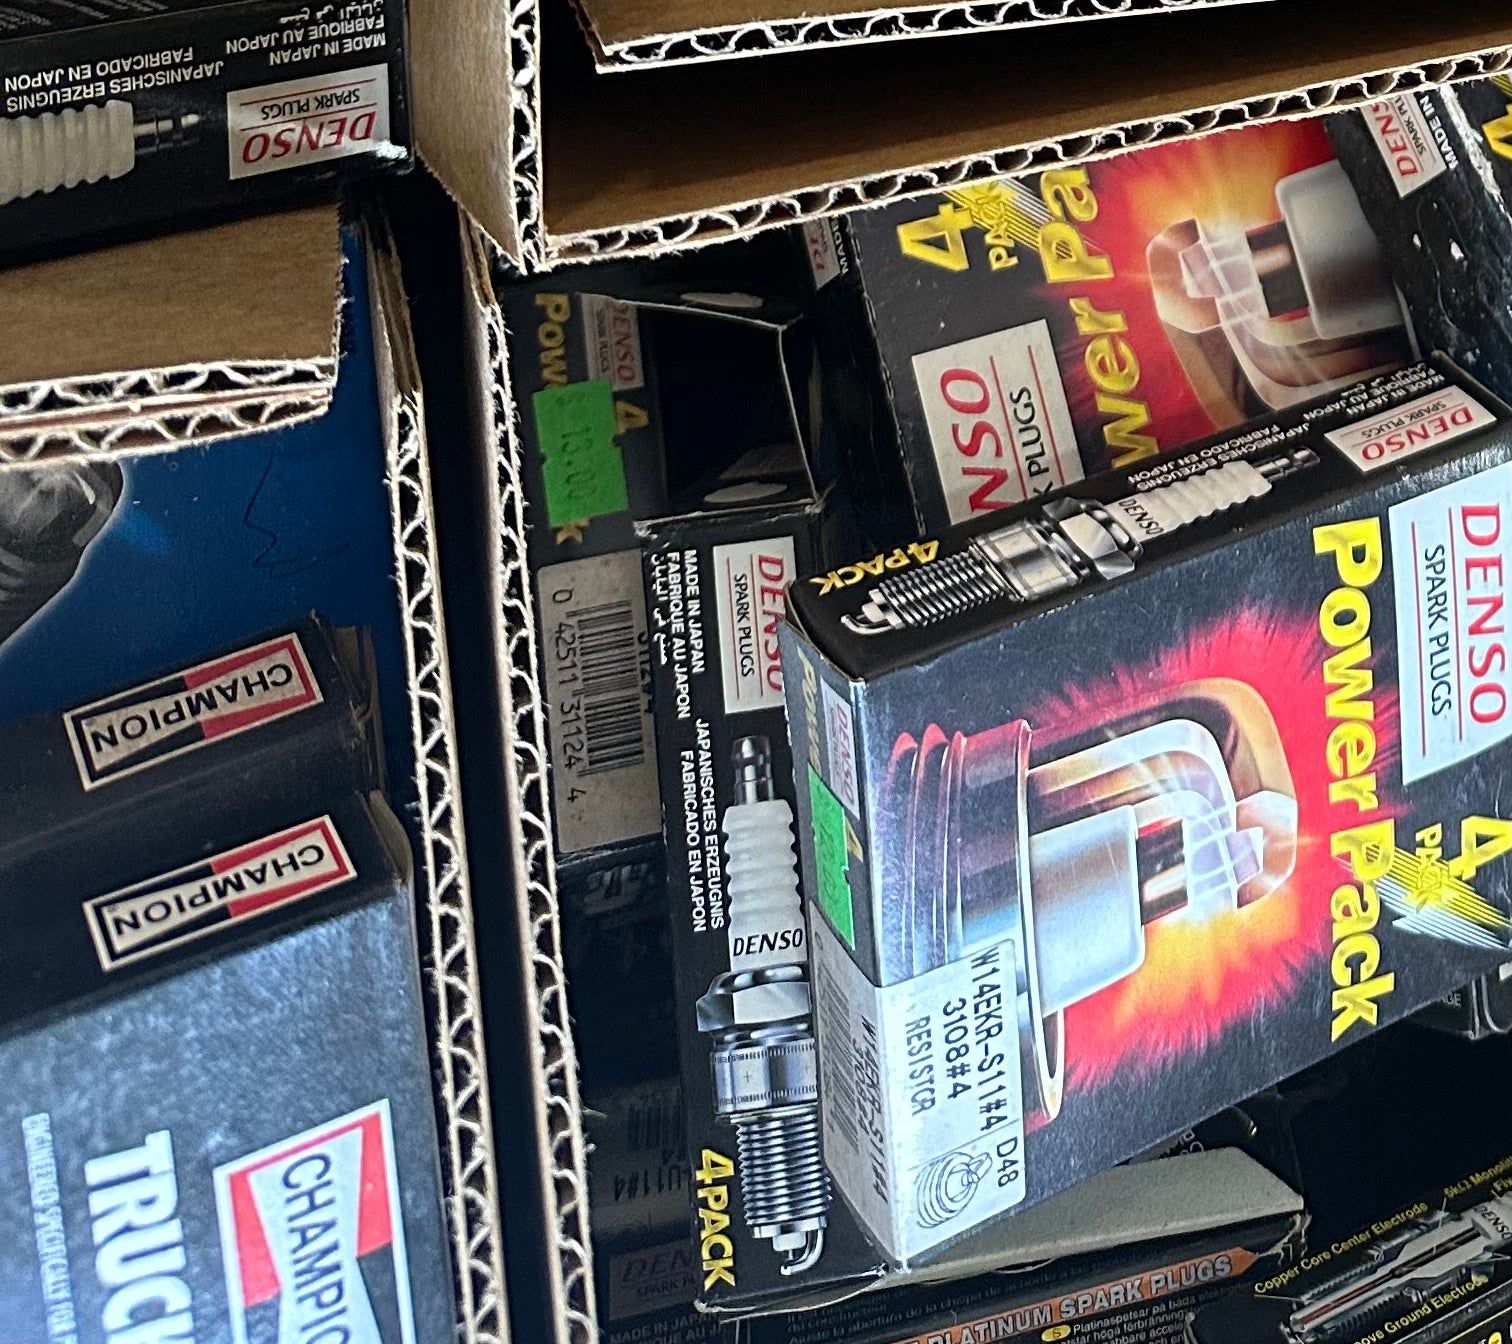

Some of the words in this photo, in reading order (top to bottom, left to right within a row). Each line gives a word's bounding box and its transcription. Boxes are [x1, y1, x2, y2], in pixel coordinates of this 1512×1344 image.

[226, 32, 280, 55] JAPON
[283, 25, 305, 43] AU
[315, 14, 385, 40] FABRIQUE
[324, 40, 341, 55] IN
[343, 32, 386, 51] MADE
[4, 68, 65, 93] JAPON
[69, 63, 92, 81] EN
[97, 46, 194, 76] FABRICADO
[109, 60, 224, 95] JAPANISCHES
[269, 43, 322, 66] JAPAN
[6, 81, 106, 112] ERZEUGNIS
[261, 97, 311, 121] PLUGS
[315, 87, 361, 111] SPARK
[242, 111, 377, 164] DENSO
[1360, 406, 1474, 461] DENSO
[552, 588, 574, 604] 0
[666, 552, 684, 628] FABRIQUE
[684, 549, 699, 593] MADE
[1421, 543, 1450, 632] SPARK
[686, 597, 700, 615] IN
[732, 572, 752, 624] SPARK
[1458, 501, 1509, 726] DENSO
[554, 623, 582, 698] 42511
[671, 632, 686, 652] AU
[688, 618, 706, 674] JAPAN
[737, 626, 756, 677] PLUGS
[1311, 515, 1386, 813] Power
[674, 657, 692, 720] JAPON
[1425, 636, 1454, 719] PLUGS
[89, 661, 296, 755] CHAMPION
[560, 699, 586, 770] 31124
[566, 787, 587, 803] 4
[680, 750, 703, 839] FABRICADO
[695, 718, 718, 836] JAPANISCHES
[687, 844, 704, 862] EN
[112, 842, 327, 936] CHAMPION
[692, 866, 708, 933] JAPON
[706, 840, 725, 929] ERZEUGNIS
[732, 928, 804, 958] DENSO
[1329, 814, 1398, 1045] Pack
[904, 1014, 937, 1116] RESISTOR
[941, 997, 973, 1102] 3108#4
[994, 1138, 1021, 1190] D48
[1253, 1261, 1304, 1300] Copper
[1299, 1245, 1335, 1274] Core
[1330, 1224, 1376, 1259] Center
[1371, 1197, 1430, 1239] Electrode
[926, 1304, 1053, 1344] PLATINUM
[1059, 1278, 1143, 1320] SPARK
[1149, 1255, 1233, 1295] PLUGS
